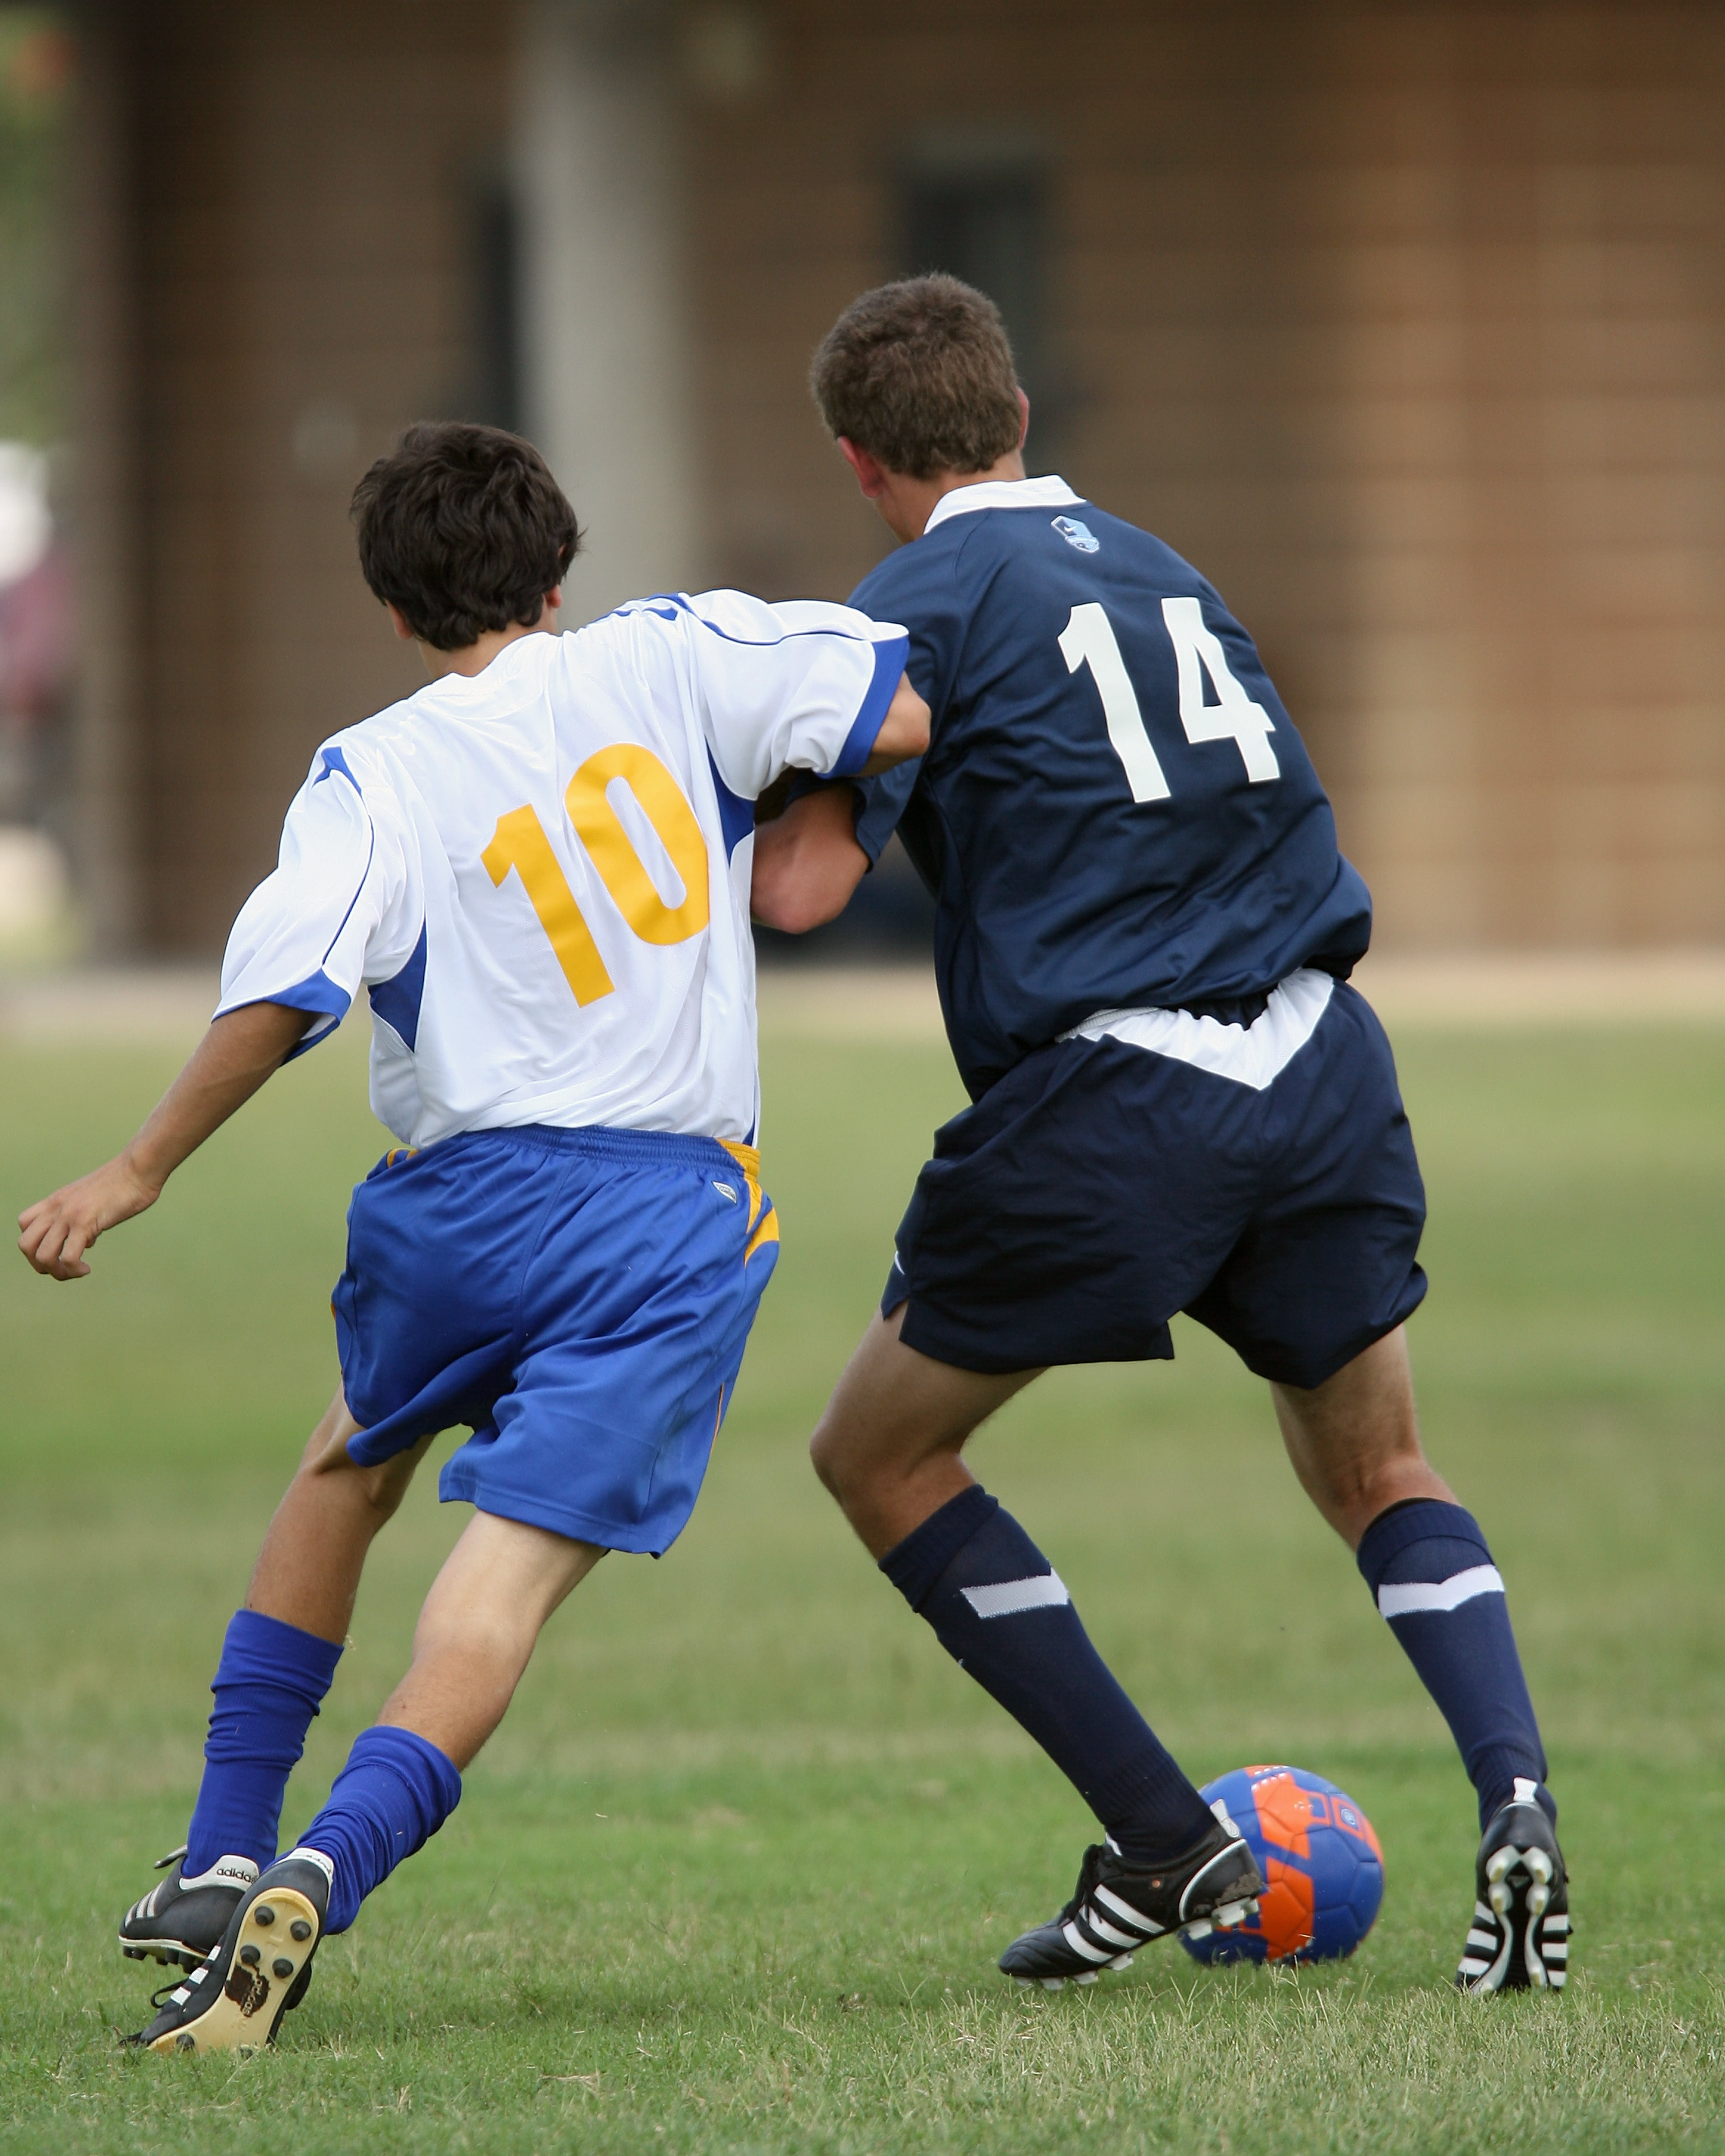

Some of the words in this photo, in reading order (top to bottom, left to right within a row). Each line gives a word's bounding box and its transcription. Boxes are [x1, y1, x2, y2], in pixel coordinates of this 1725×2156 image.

[1057, 597, 1280, 803] 14
[480, 742, 709, 1008] 10
[217, 1868, 255, 1883] adidas
